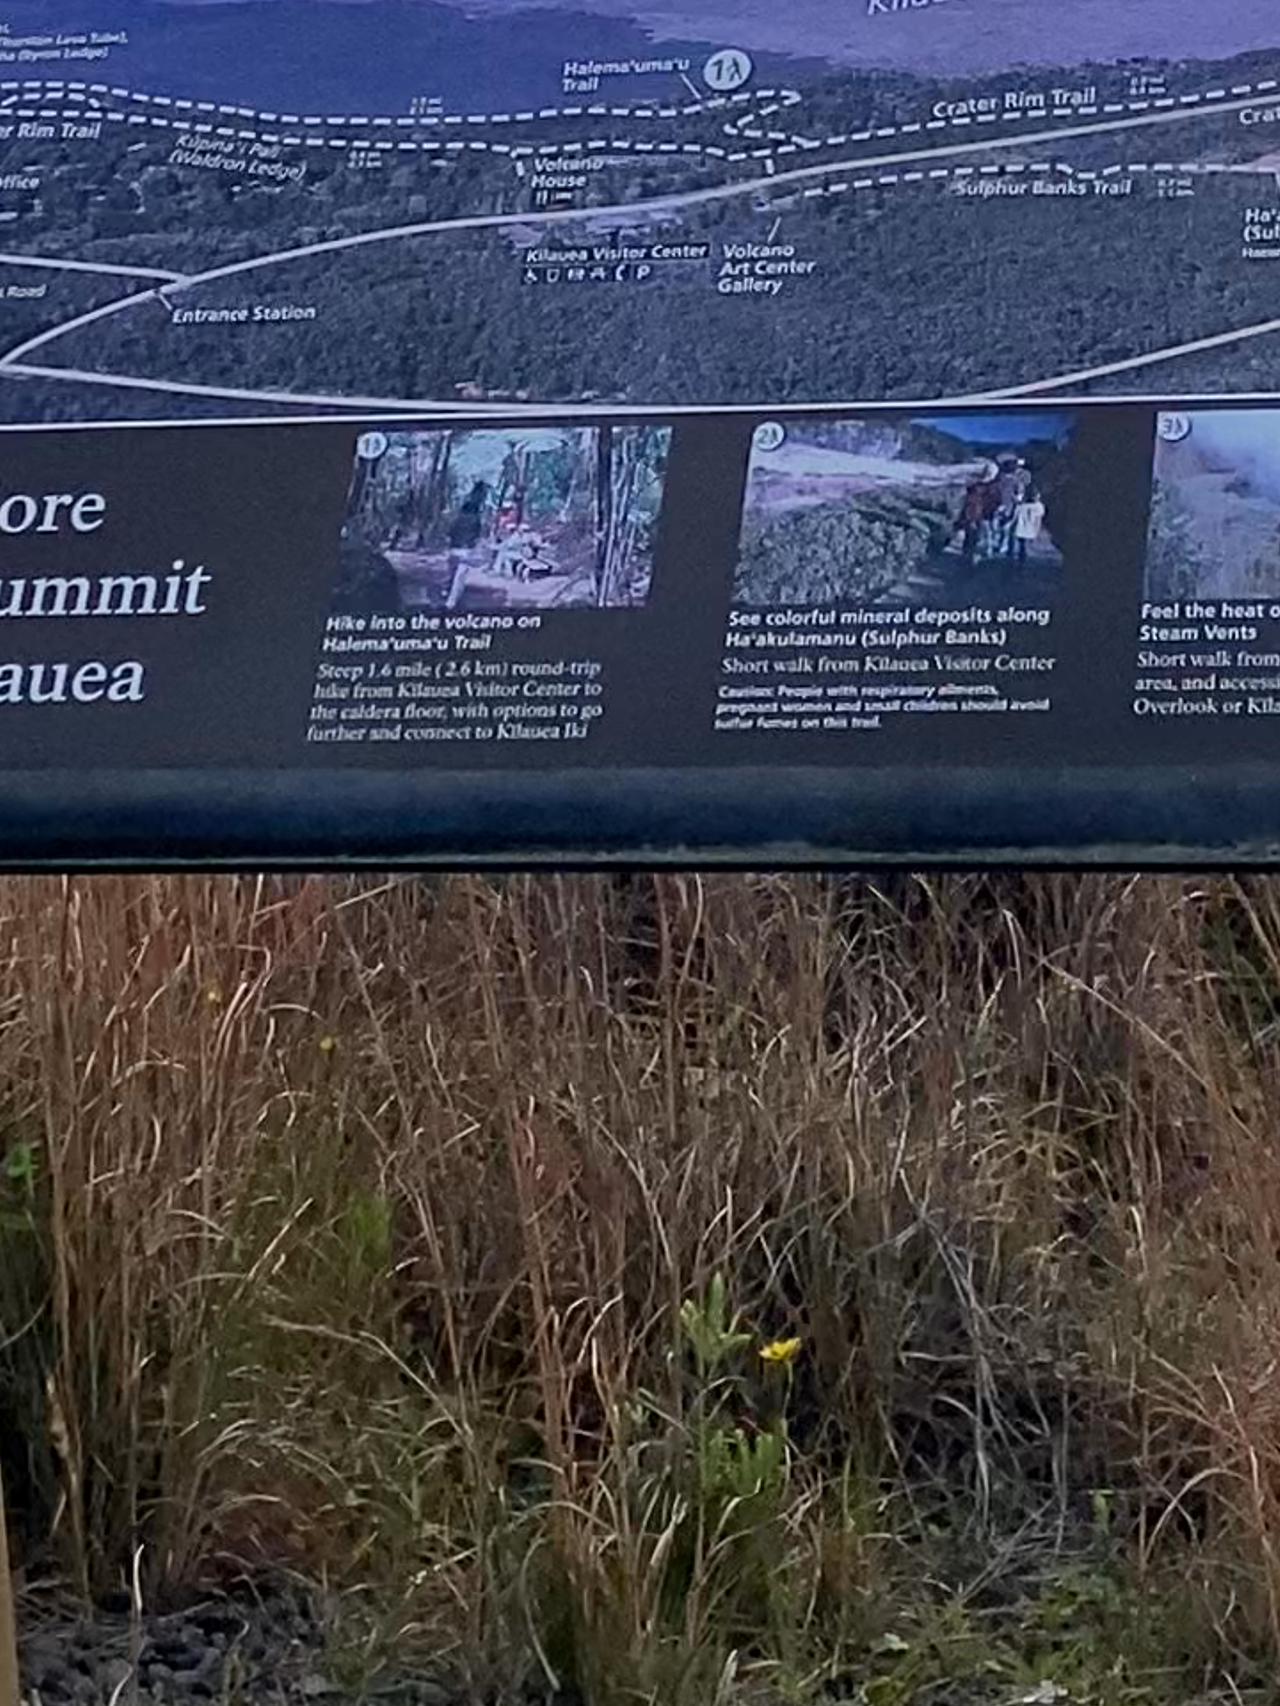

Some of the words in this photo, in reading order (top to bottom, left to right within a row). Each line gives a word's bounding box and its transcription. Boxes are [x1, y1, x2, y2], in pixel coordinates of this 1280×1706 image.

[710, 59, 726, 81] 1
[563, 77, 598, 92] Trail
[932, 96, 999, 121] Crater
[1003, 92, 1047, 111] Rim
[1051, 87, 1096, 107] Trail
[17, 123, 56, 138] Rim
[60, 123, 100, 138] Trail
[169, 150, 247, 172] (Waldron
[250, 159, 306, 181] Ledge)
[534, 158, 604, 173] Volcano
[531, 173, 587, 188] House
[953, 179, 1030, 200] Sulphur
[1032, 179, 1088, 196] Banks
[1091, 179, 1131, 195] Trail
[723, 243, 795, 259] Volcano
[720, 261, 749, 275] Art
[753, 260, 816, 275] Center
[718, 278, 783, 296] Gallery
[173, 308, 248, 323] Entrance
[253, 305, 315, 320] Station
[729, 611, 761, 627] See
[766, 609, 836, 626] colorful
[840, 608, 910, 625] mineral
[914, 607, 992, 627] deposits
[996, 606, 1050, 626] along
[1142, 603, 1179, 619] Feel
[1185, 603, 1216, 618] the
[1221, 603, 1265, 618] heat
[326, 615, 365, 631] Hike
[370, 615, 405, 631] into
[411, 614, 439, 630] the
[444, 614, 513, 629] volcano
[517, 615, 541, 628] on
[861, 629, 939, 649] (Sulphur
[943, 628, 1007, 646] Banks)
[1140, 625, 1199, 641] Steam
[1204, 625, 1257, 640] Vents
[454, 635, 492, 649] Trail
[1137, 652, 1186, 668] Short
[1190, 651, 1232, 667] walk
[1237, 651, 1280, 667] from
[317, 663, 363, 681] Steep
[369, 662, 391, 678] 1.6
[394, 662, 432, 678] mile
[474, 659, 508, 678] km)
[511, 659, 602, 681] round-trip
[1135, 677, 1178, 692] area,
[1181, 674, 1216, 690] and
[1133, 698, 1218, 715] Overlook
[1222, 700, 1243, 714] or
